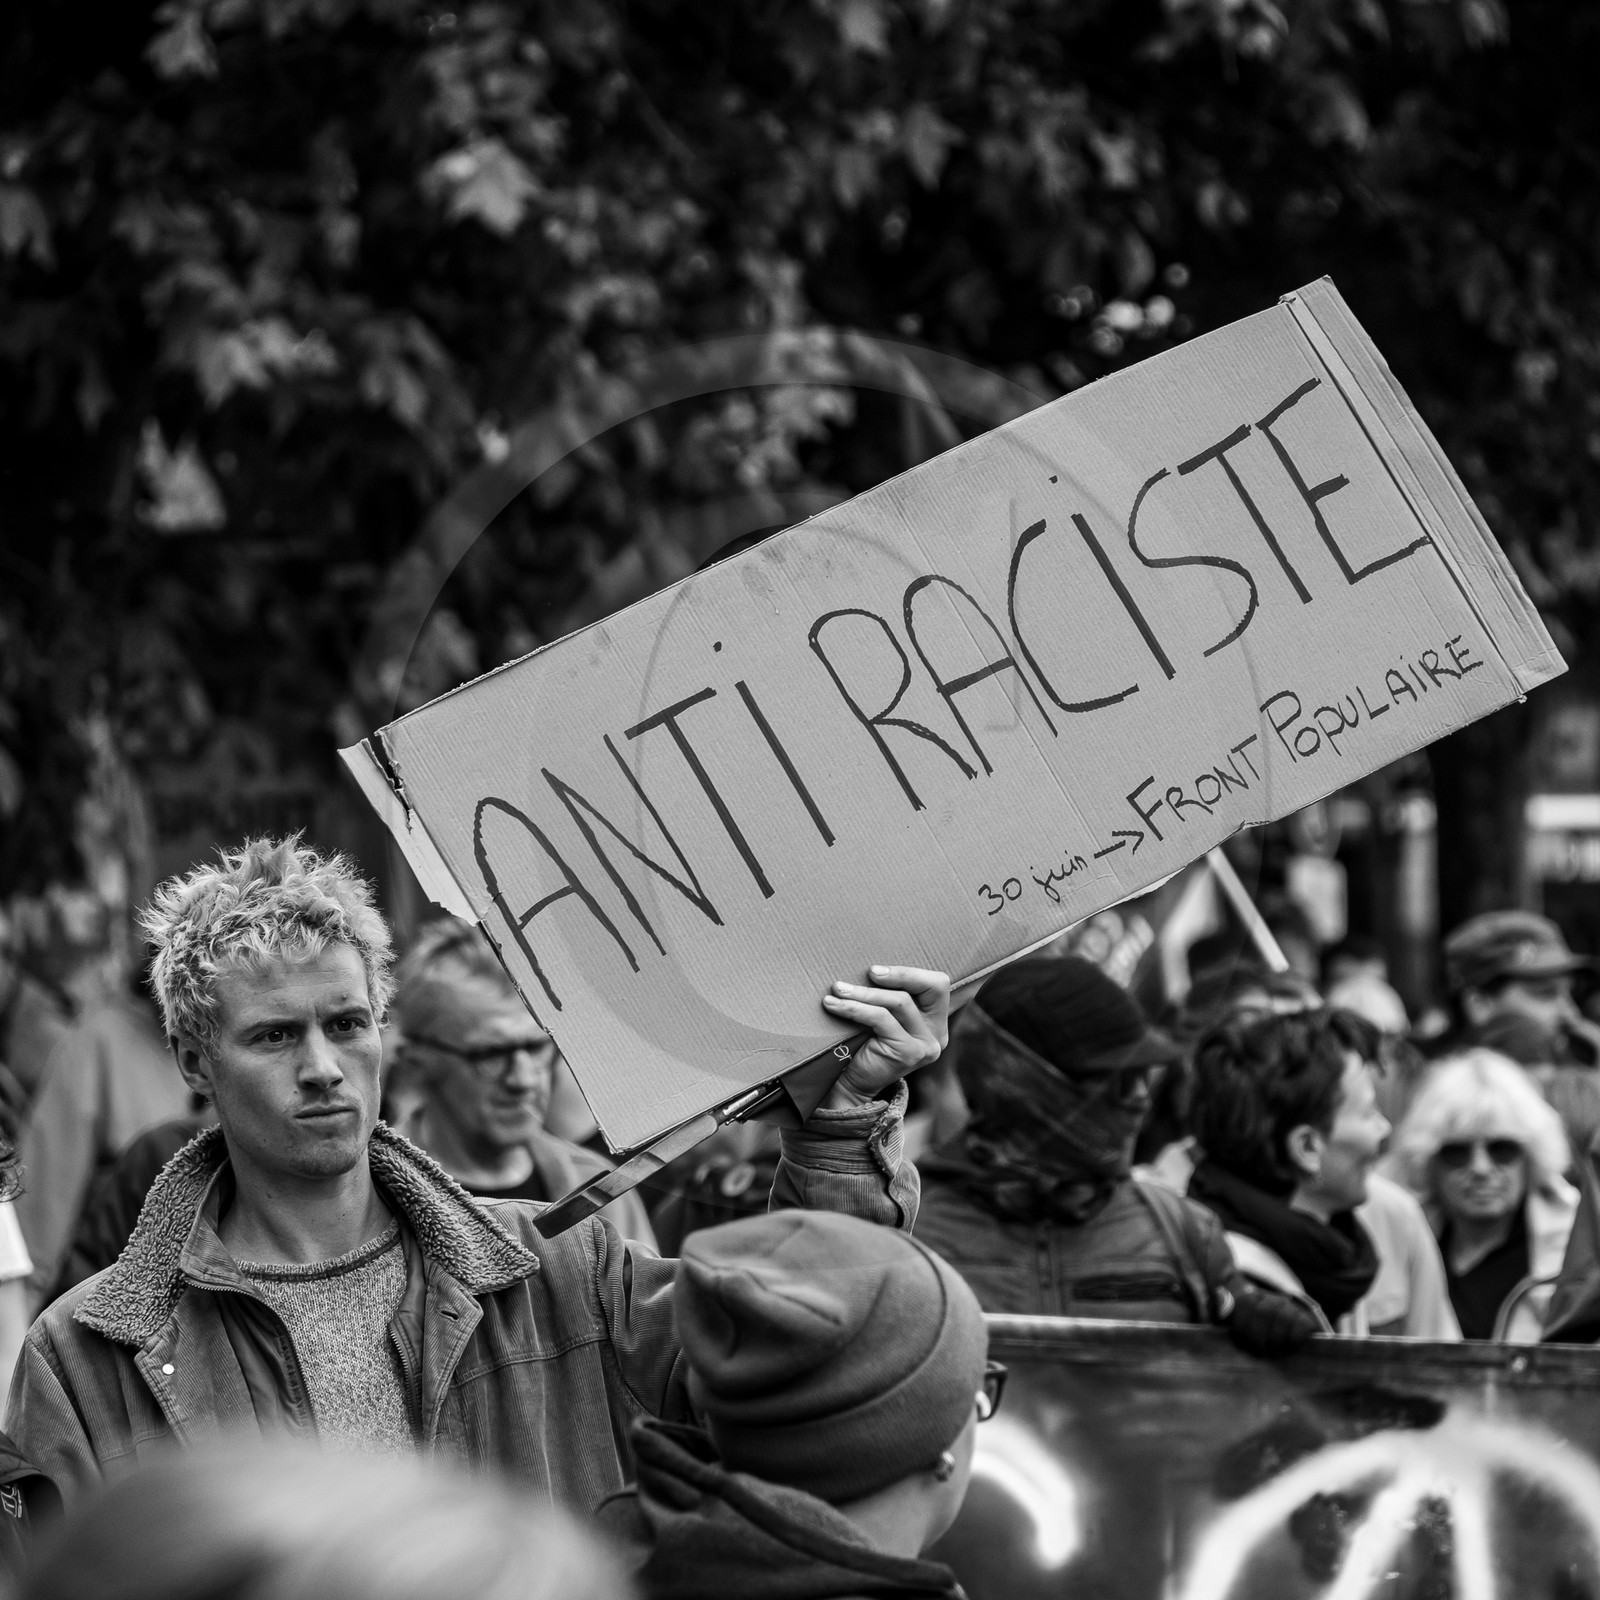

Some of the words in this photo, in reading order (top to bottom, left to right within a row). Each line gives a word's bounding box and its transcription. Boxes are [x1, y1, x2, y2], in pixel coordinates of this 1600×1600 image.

[978, 877, 1022, 916] 30
[1029, 850, 1088, 904] juin
[1125, 734, 1260, 842] FRONT
